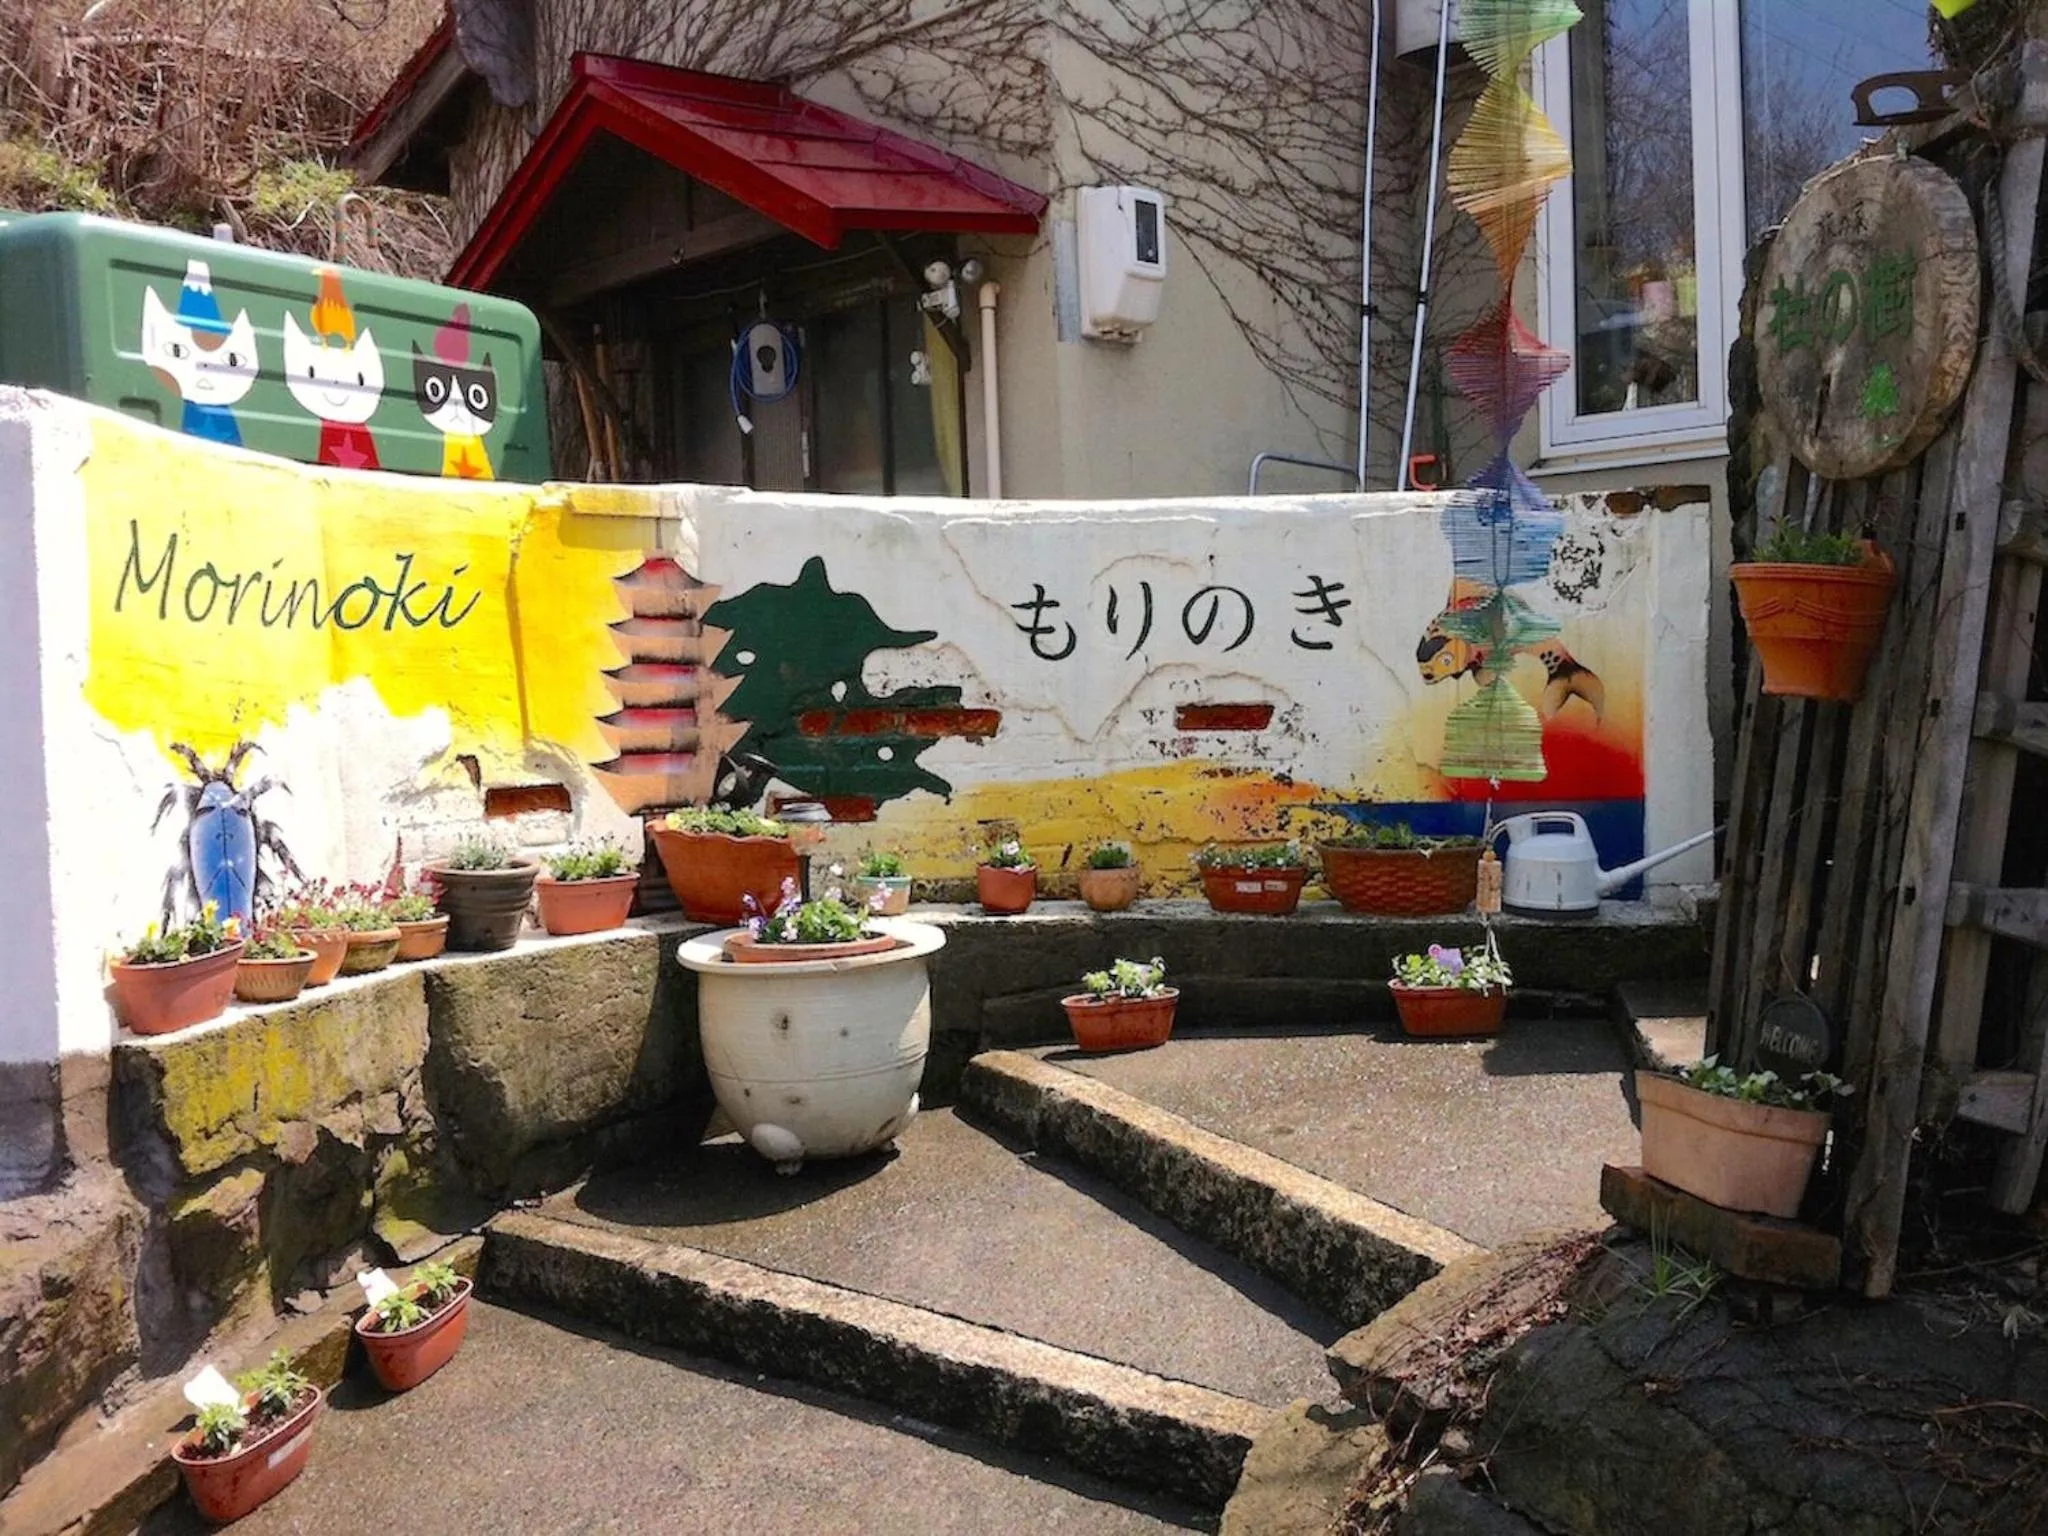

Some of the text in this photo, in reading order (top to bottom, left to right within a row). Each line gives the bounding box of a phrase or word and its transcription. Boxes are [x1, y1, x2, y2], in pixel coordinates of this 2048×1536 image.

[115, 519, 481, 631] Morinoki
[1011, 575, 1351, 661] もりのき
